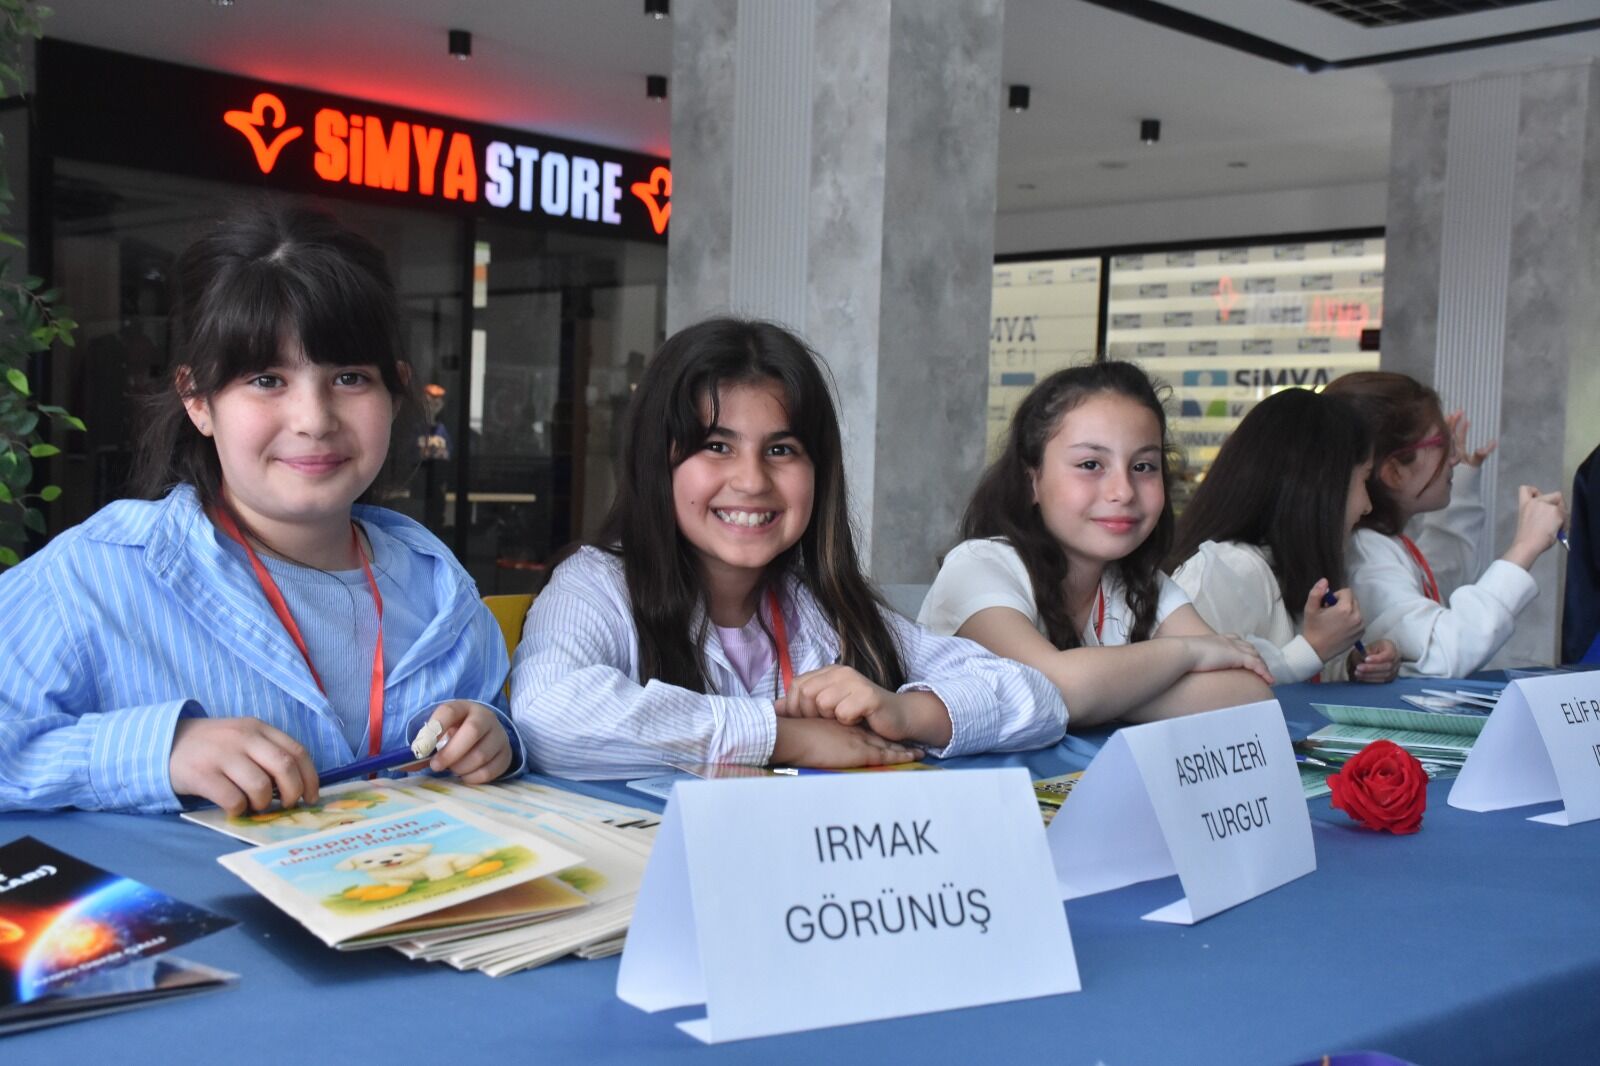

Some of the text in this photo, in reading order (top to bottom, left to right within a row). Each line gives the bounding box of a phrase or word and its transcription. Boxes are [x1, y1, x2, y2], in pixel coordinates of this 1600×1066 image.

[485, 141, 623, 225] STORE
[1560, 696, 1590, 725] ELİF
[1175, 733, 1267, 787] ASRİN ZERİ
[815, 819, 939, 863] IRMAK
[1201, 796, 1271, 842] TURGUT
[785, 881, 992, 944] GÖRÜNÜŞ
